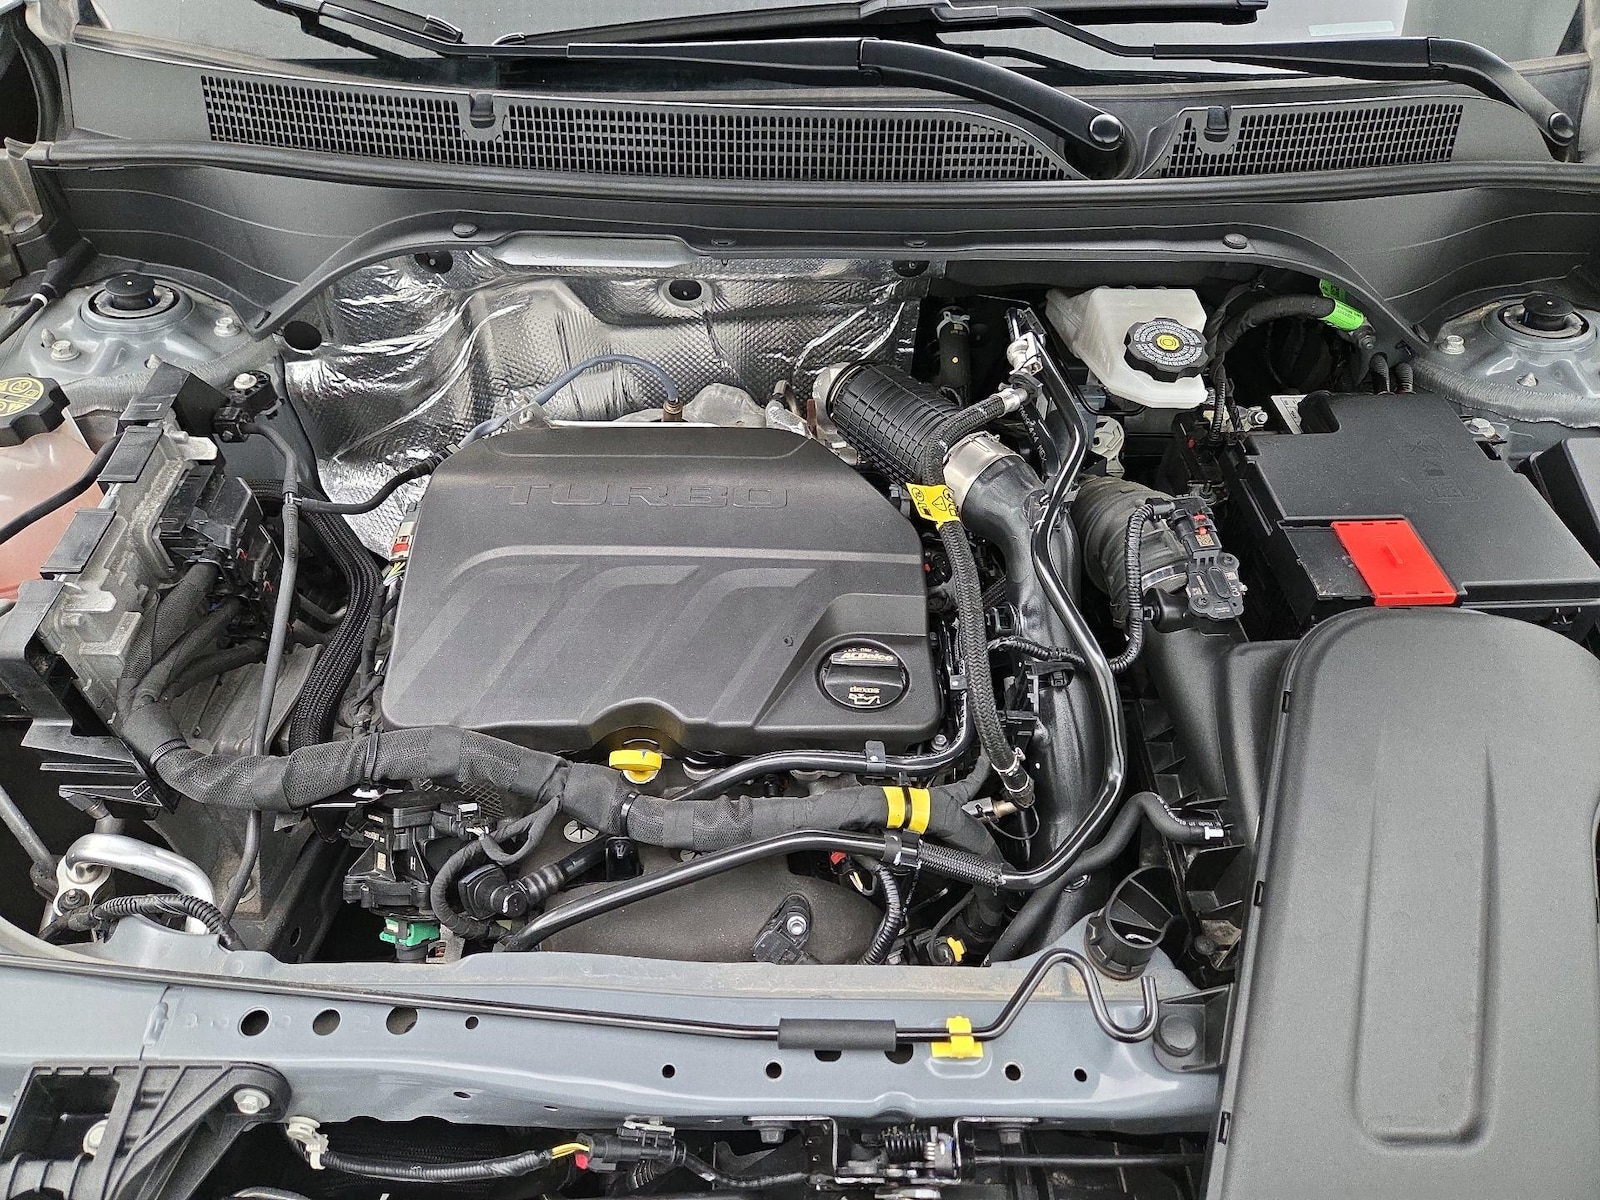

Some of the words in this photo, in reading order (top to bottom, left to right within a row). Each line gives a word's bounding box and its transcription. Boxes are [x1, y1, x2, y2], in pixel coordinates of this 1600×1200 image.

[494, 483, 788, 508] TURBO
[841, 652, 894, 661] ACDelco
[849, 686, 881, 694] dexos
